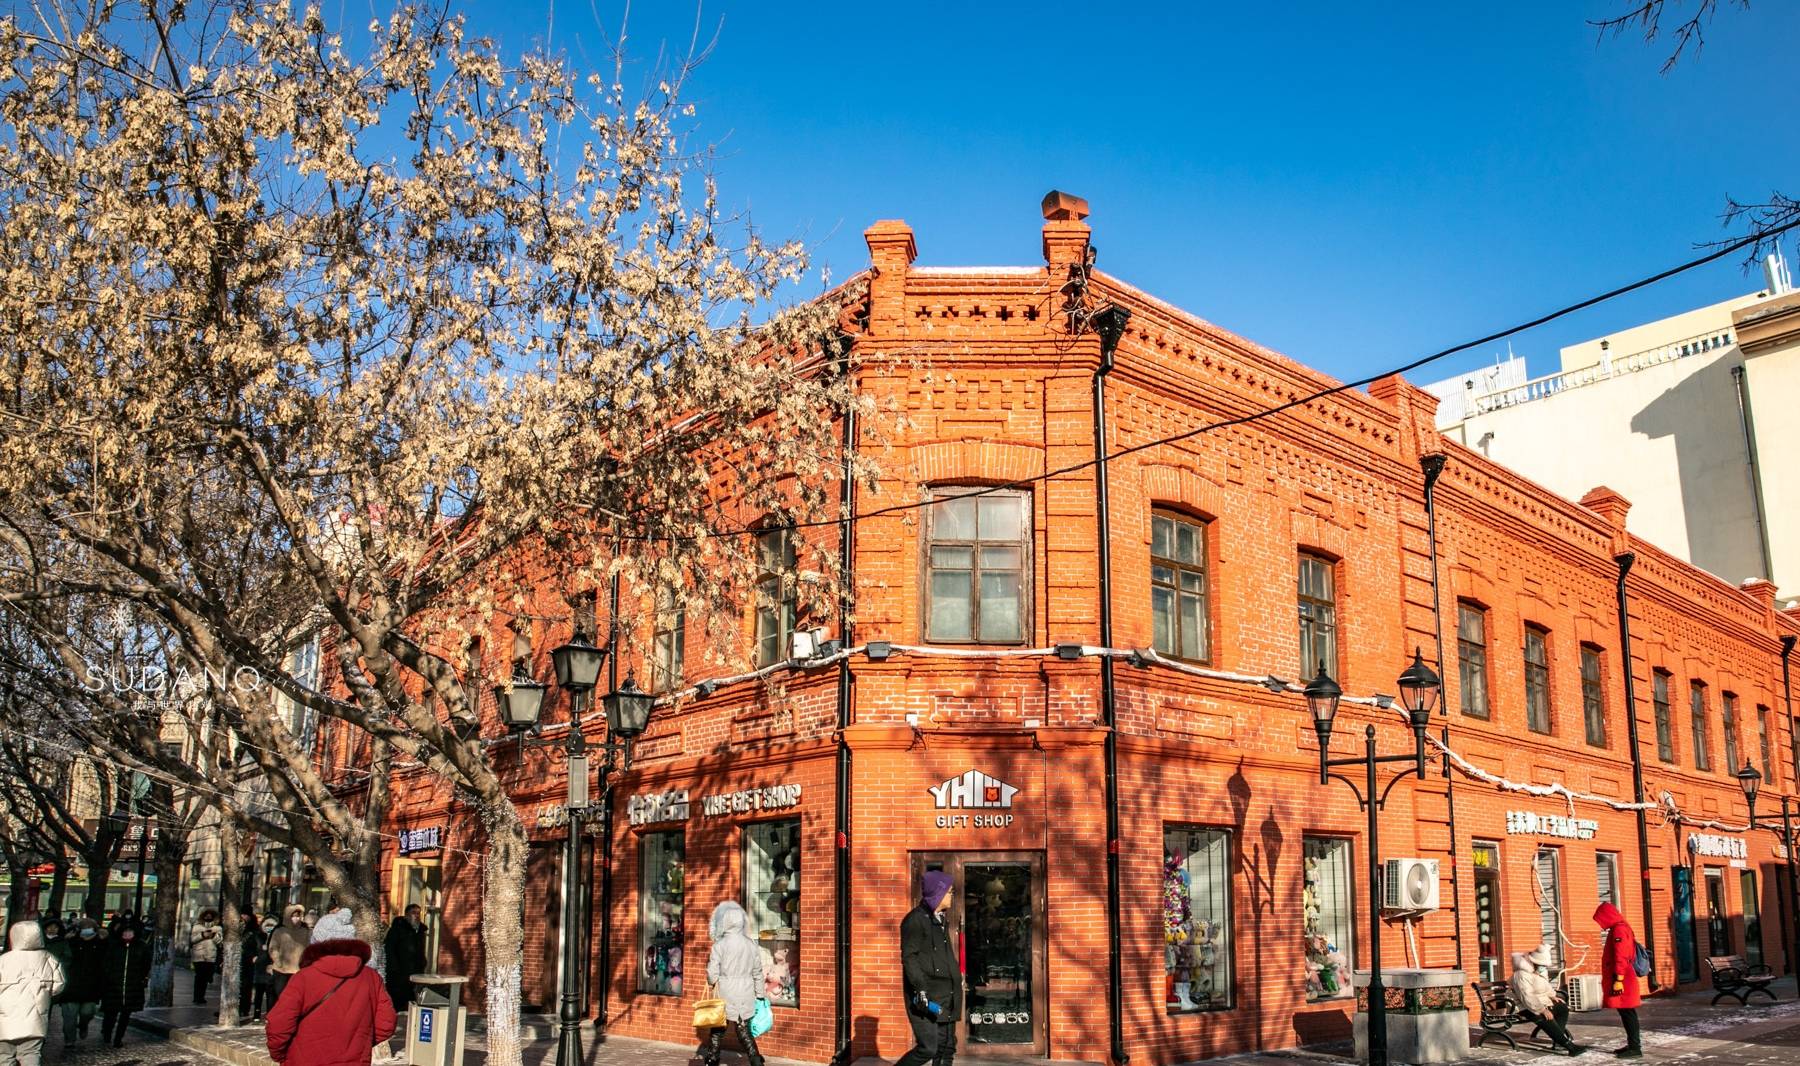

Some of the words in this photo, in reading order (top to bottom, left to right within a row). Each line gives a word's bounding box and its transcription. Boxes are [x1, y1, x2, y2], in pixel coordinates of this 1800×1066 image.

[732, 788, 762, 812] GIFT
[763, 783, 802, 808] SHOP
[936, 815, 969, 828] GIFT
[974, 814, 1014, 827] SHOP
